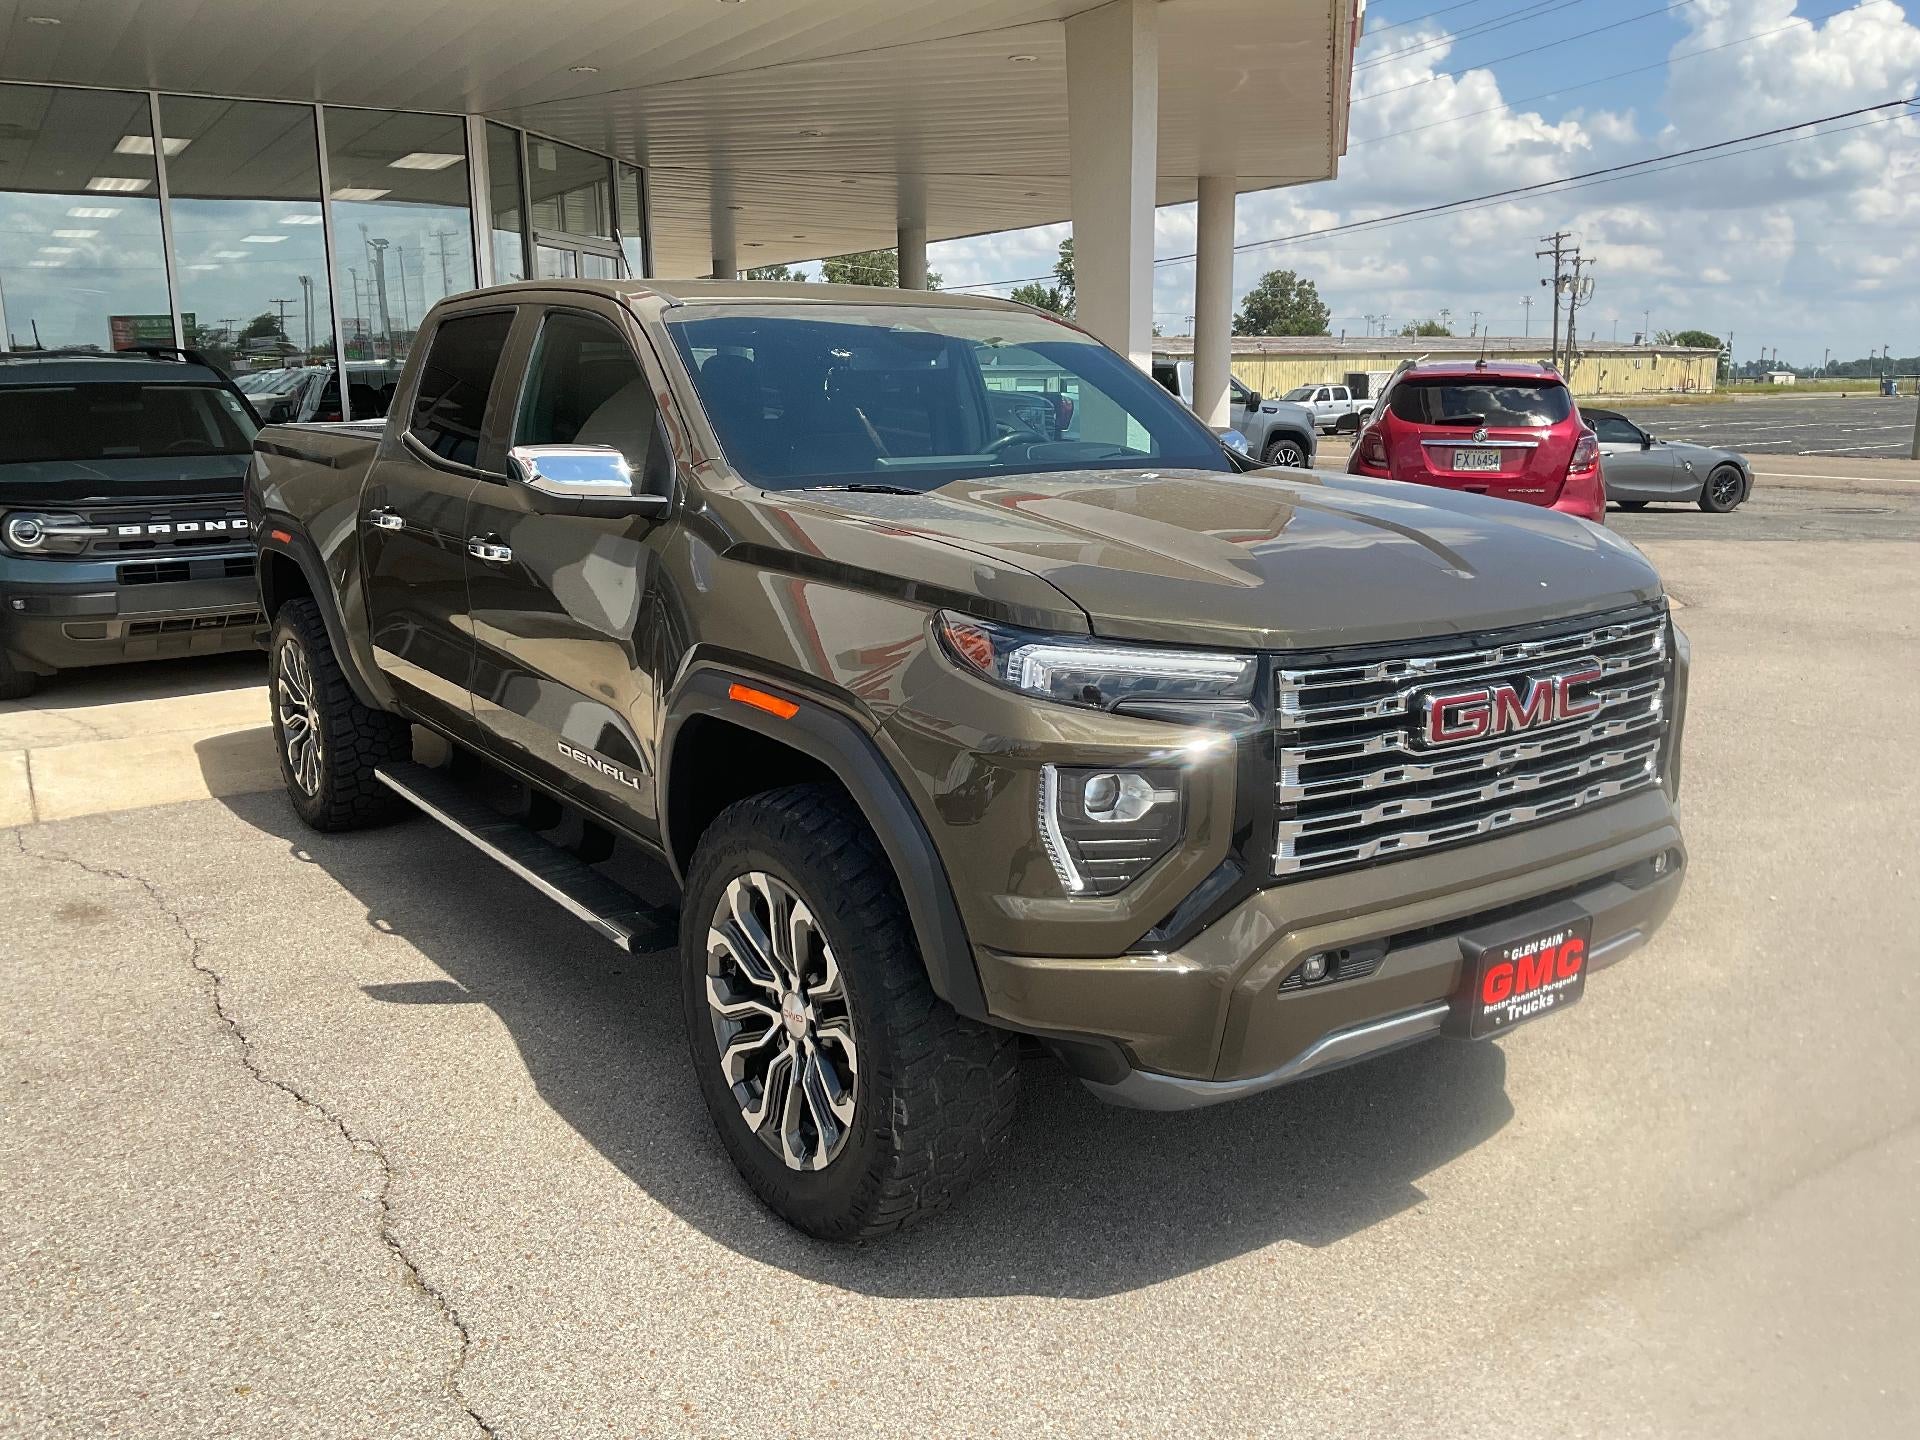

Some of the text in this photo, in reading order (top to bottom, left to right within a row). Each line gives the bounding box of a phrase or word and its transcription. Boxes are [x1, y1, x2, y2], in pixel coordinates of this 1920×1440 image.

[1455, 453, 1499, 466] FX16454
[118, 519, 248, 535] BRONC
[1425, 662, 1602, 744] GMC
[557, 742, 640, 790] DENALI
[1511, 933, 1563, 961] GLEN SAIN
[1482, 939, 1584, 1004] GMC
[783, 1007, 804, 1023] GMC
[1507, 994, 1554, 1021] Trucks
